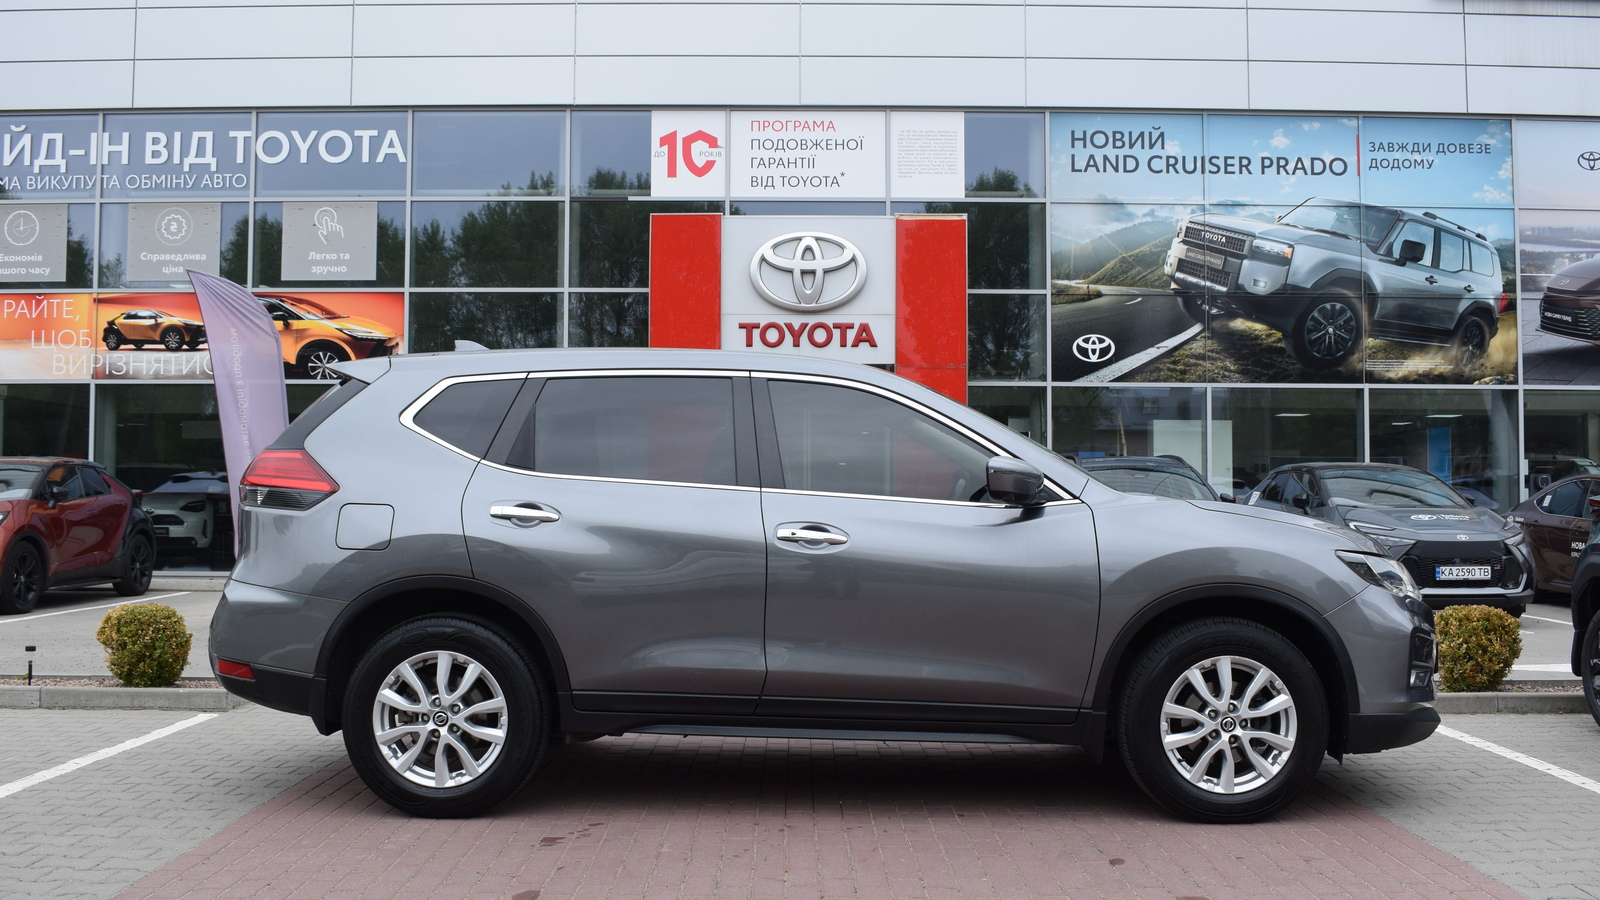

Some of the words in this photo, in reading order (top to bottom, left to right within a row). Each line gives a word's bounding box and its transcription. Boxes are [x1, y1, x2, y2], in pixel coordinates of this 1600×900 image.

[750, 120, 836, 132] ПРОГРАМА
[750, 136, 865, 153] ПОДОВЖЕНОЇ
[1070, 126, 1166, 150] НОВИЙ
[145, 131, 217, 172] ВІД
[229, 129, 407, 165] TOYOTA
[1368, 141, 1433, 156] ЗАВЖДИ
[1435, 143, 1492, 157] ДОВЕЗЕ
[750, 154, 817, 169] ГАРАНТІЇ
[1070, 154, 1139, 174] LAND
[1147, 155, 1252, 176] CRUISER
[1260, 156, 1348, 177] PRADO
[1368, 157, 1434, 171] ДОДОМУ
[26, 175, 97, 190] ВИКУПУ
[101, 174, 121, 189] ТА
[125, 174, 197, 189] ОБМІНУ
[200, 173, 247, 188] АВТО
[750, 175, 776, 190] ВІД
[1201, 231, 1226, 243] TOYOTA
[140, 252, 207, 263] Справедлива
[308, 251, 336, 262] Легко
[339, 252, 350, 262] та
[28, 267, 51, 276] часу
[162, 264, 184, 274] ціна
[311, 264, 347, 276] зручно
[31, 329, 92, 352] ЩОБ
[738, 321, 878, 348] TOYOTA
[1440, 567, 1454, 577] KA
[1455, 567, 1476, 577] 2590
[1478, 567, 1490, 577] TB
